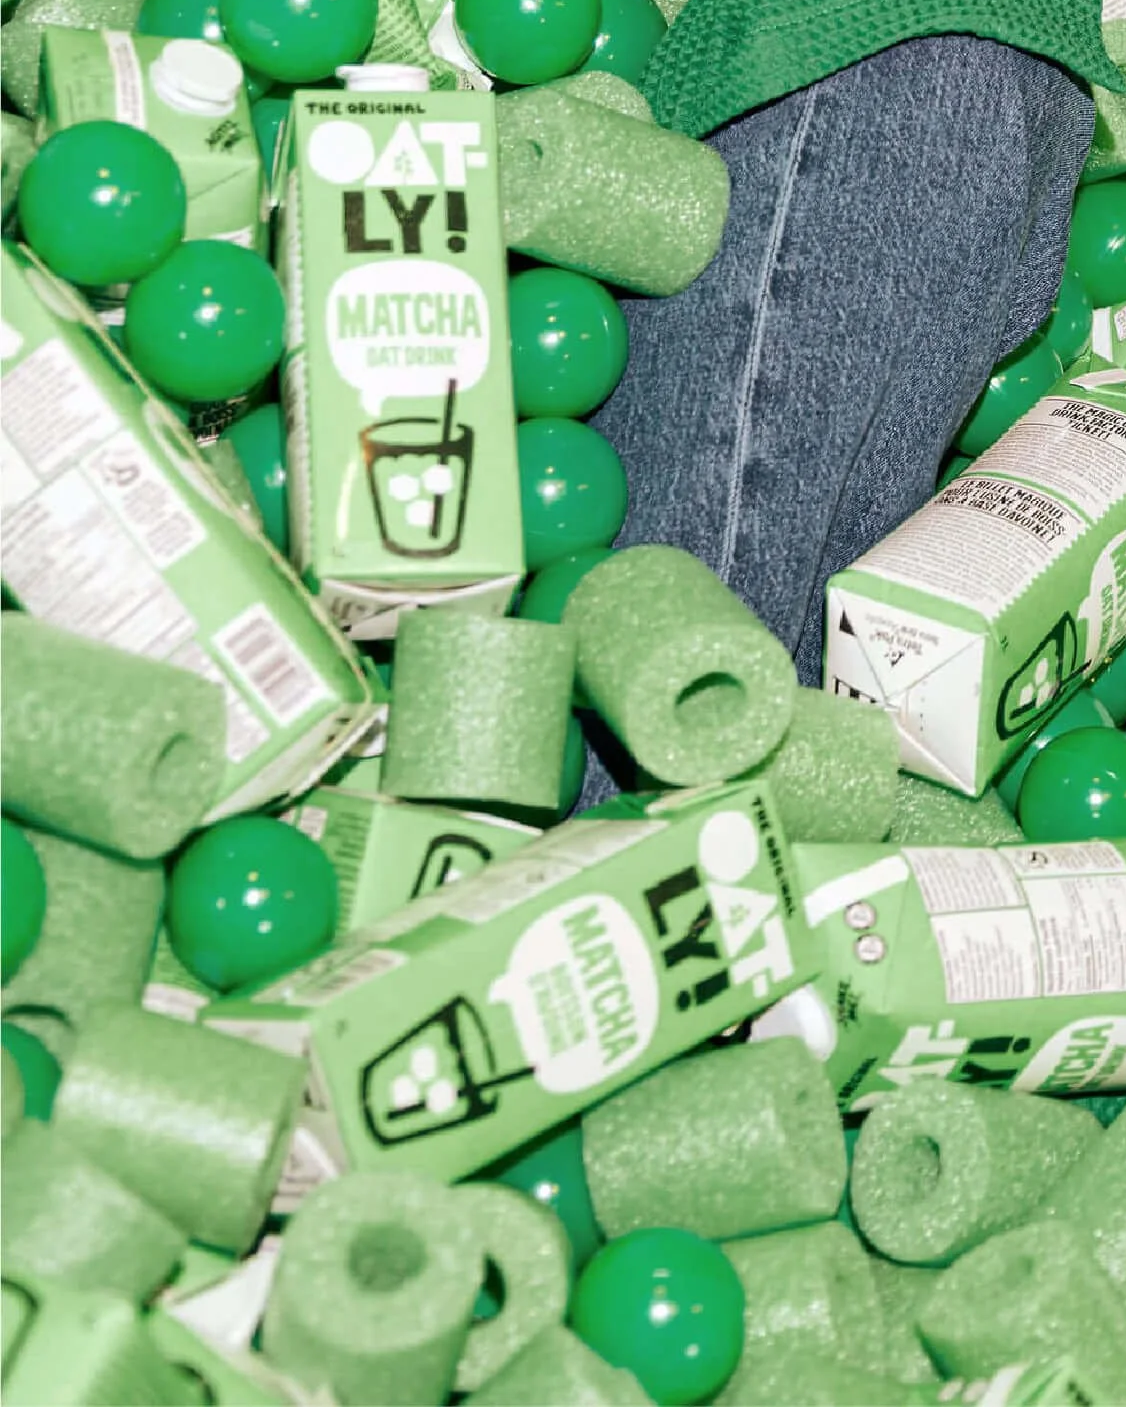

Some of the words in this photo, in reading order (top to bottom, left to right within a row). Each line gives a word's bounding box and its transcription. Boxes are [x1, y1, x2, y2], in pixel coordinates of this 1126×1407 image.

[305, 102, 341, 115] THE
[347, 101, 427, 115] ORIGINAL
[342, 187, 468, 254] LY!
[337, 293, 482, 339] MATCHA
[365, 345, 400, 368] OAT
[405, 345, 457, 367] DRINK
[1063, 401, 1084, 413] THE
[1085, 407, 1124, 426] MAGIC
[752, 795, 771, 835] THE
[644, 865, 730, 1013] LY!
[561, 904, 638, 1066] MATCHA
